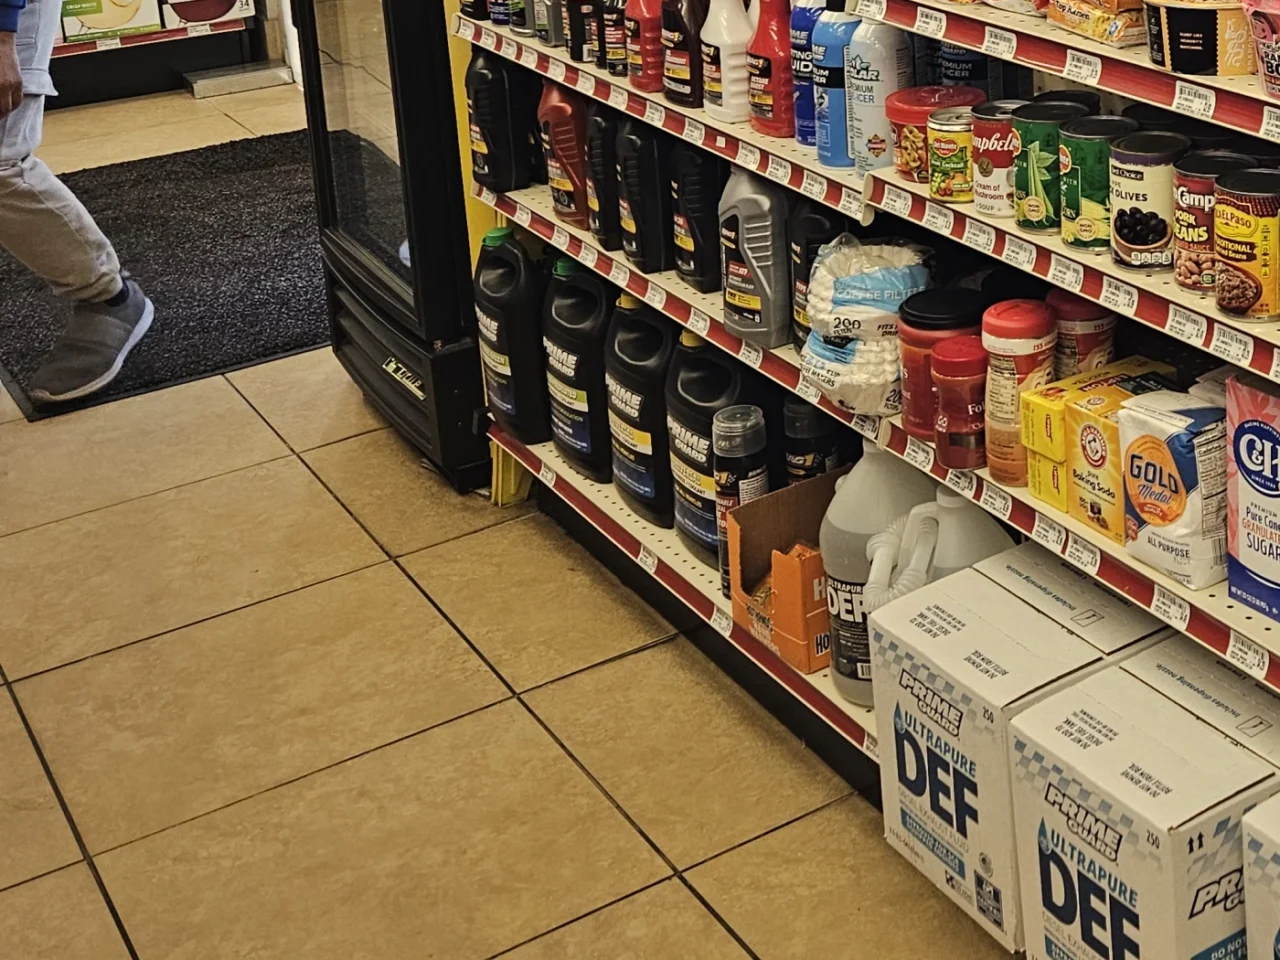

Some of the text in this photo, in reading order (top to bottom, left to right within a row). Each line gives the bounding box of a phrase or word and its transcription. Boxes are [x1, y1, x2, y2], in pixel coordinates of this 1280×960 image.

[238, 0, 250, 9] 34
[1114, 189, 1148, 202] OLIVES
[836, 289, 881, 301] COFFEE
[833, 317, 861, 329] 200
[543, 336, 579, 368] PRIME
[549, 356, 575, 377] GUARD
[605, 374, 642, 409] PRIME
[612, 396, 639, 418] GUARD
[667, 415, 711, 451] PRIME
[675, 438, 707, 463] GUARD
[1072, 468, 1115, 499] Baking Soda
[1130, 454, 1178, 494] GOLD
[1138, 484, 1172, 505] Medal
[1250, 501, 1278, 517] PREMIUM
[1246, 506, 1262, 523] Pure
[1147, 537, 1190, 558] ALL PURPOSE
[899, 668, 964, 722] PRIME
[917, 700, 959, 737] GUARD
[904, 711, 977, 778] ULTRAPURE
[894, 722, 978, 840] DEF
[1044, 783, 1122, 847] PRIME
[1066, 819, 1117, 862] GUARD
[1051, 830, 1138, 908] ULTRAPURE
[1038, 838, 1140, 960] DEF
